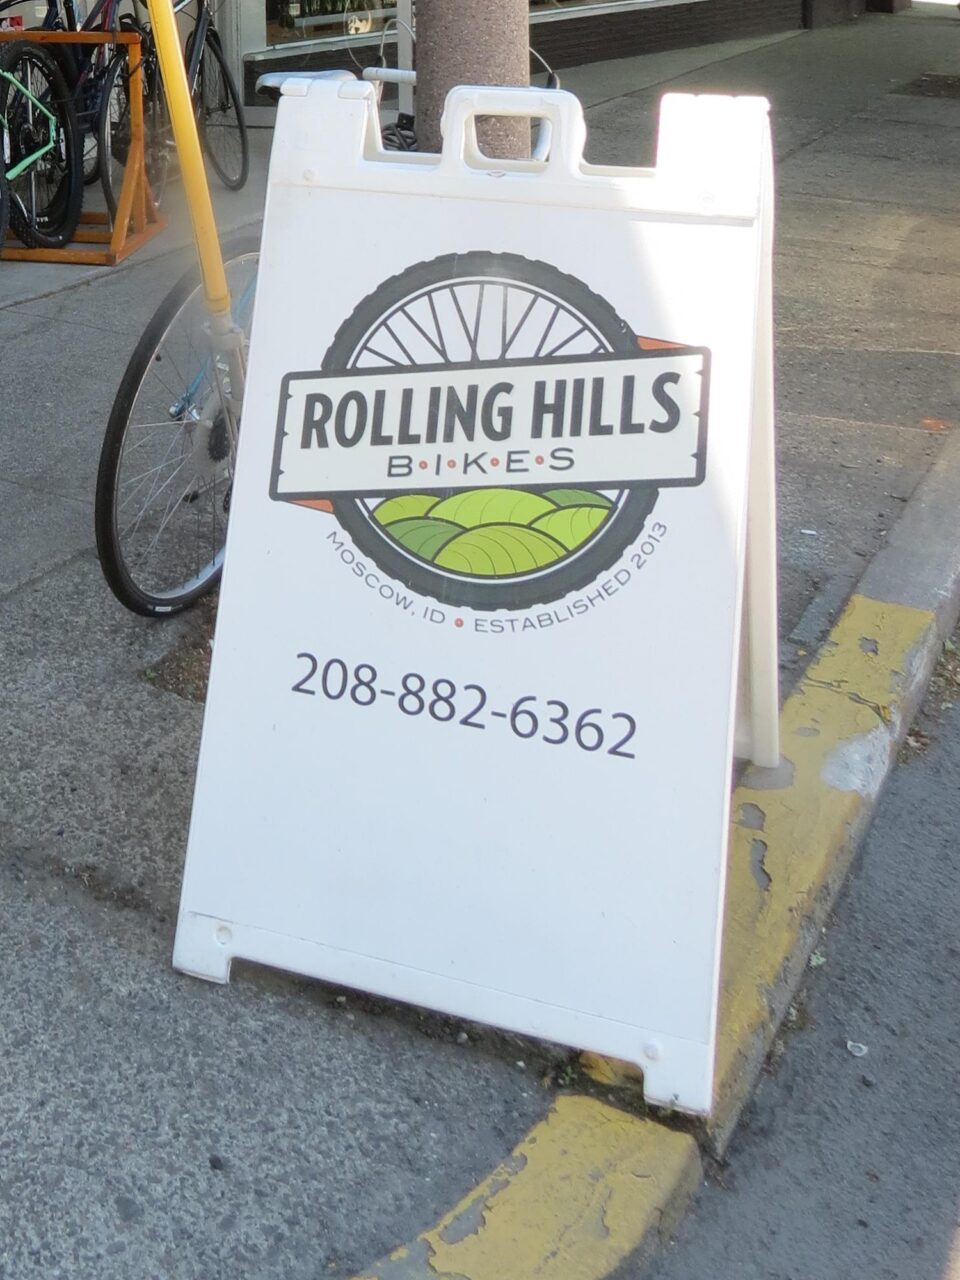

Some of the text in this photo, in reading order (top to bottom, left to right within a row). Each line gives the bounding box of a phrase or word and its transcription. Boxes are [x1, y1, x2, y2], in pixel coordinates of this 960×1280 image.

[300, 371, 681, 449] ROLLING HILLS
[326, 521, 668, 633] MOSCOW, ID ESTABLISHED 2013
[291, 651, 637, 760] 208-882-6362
